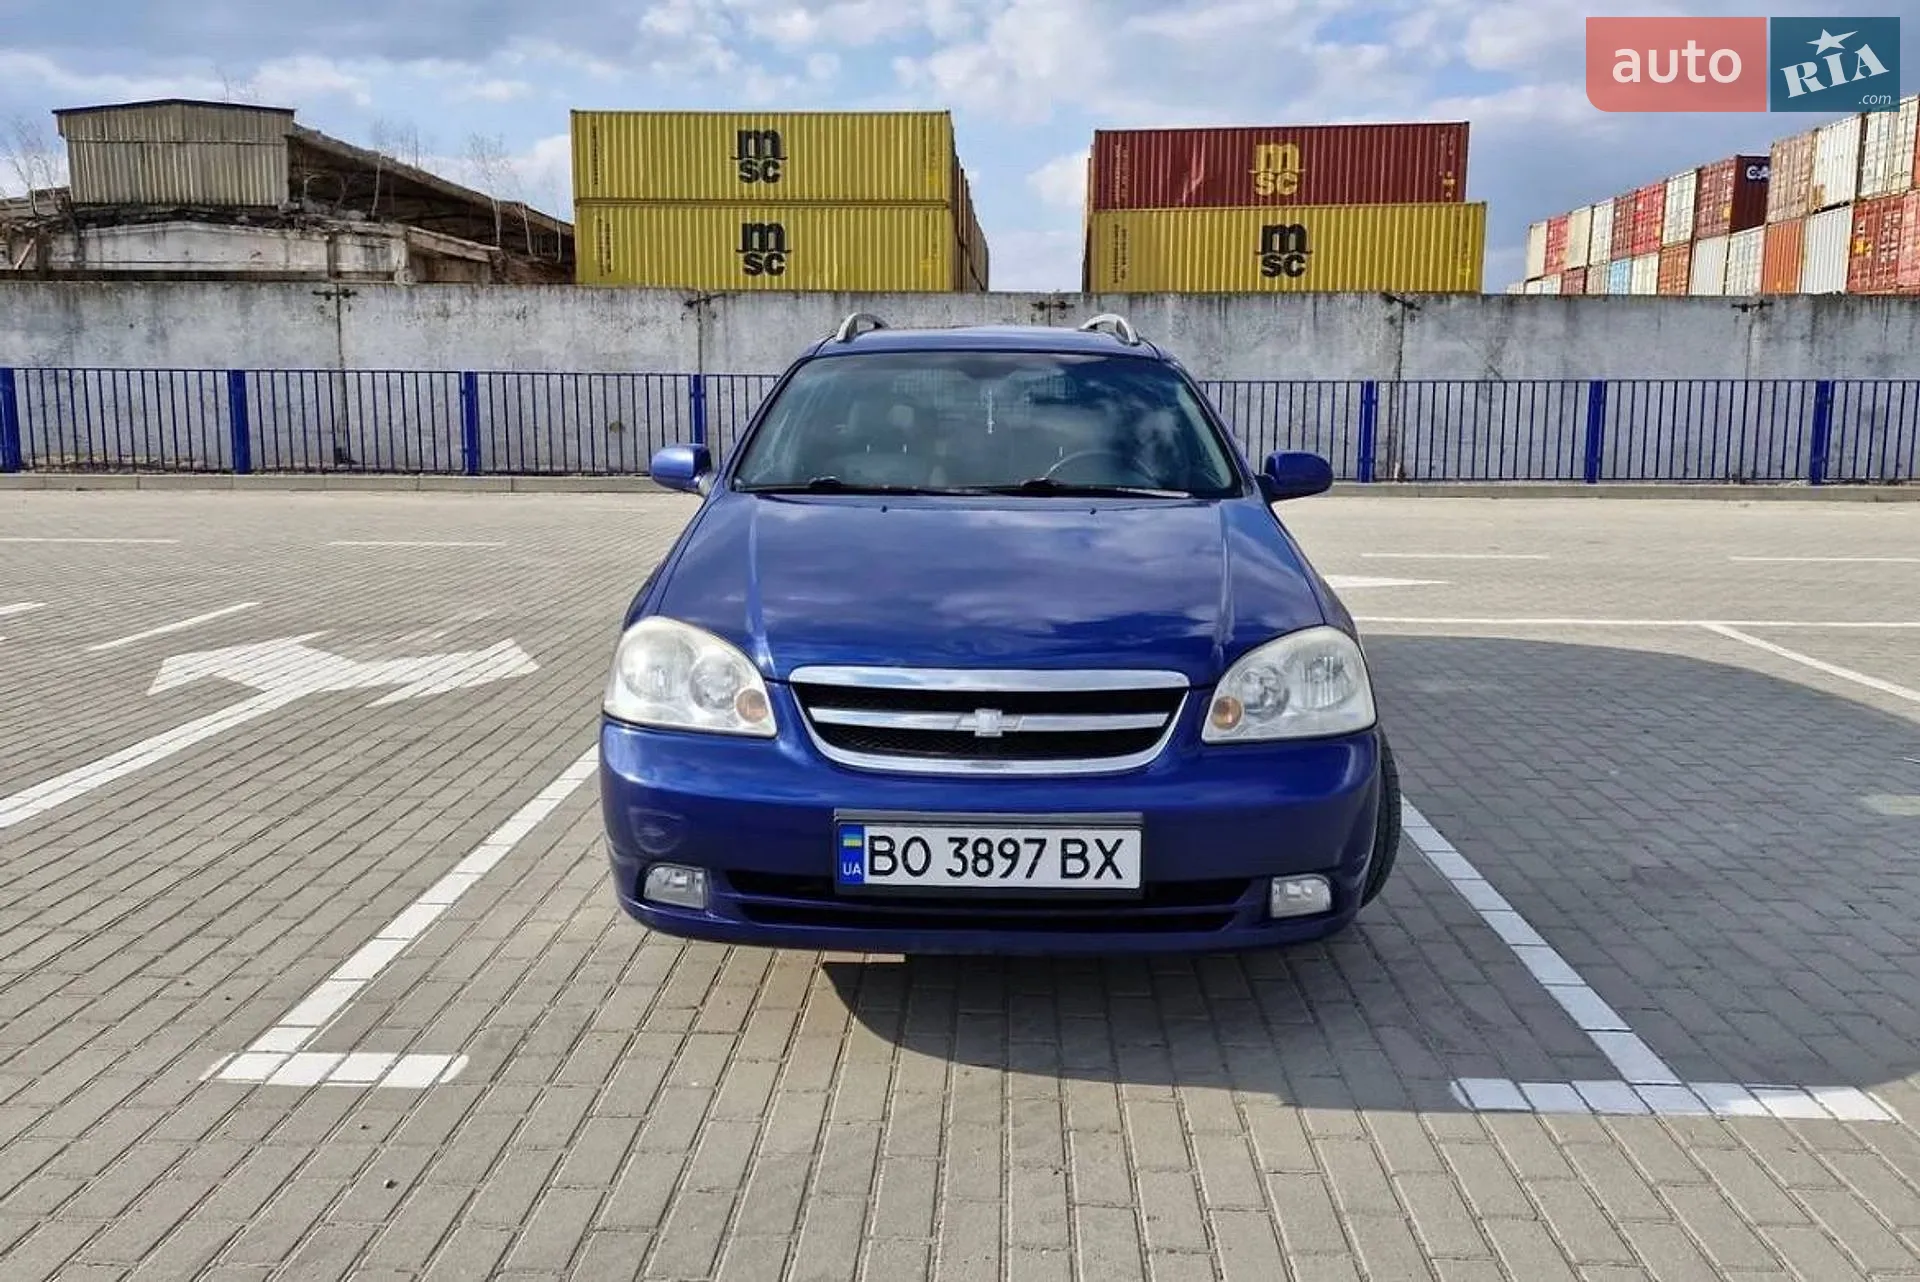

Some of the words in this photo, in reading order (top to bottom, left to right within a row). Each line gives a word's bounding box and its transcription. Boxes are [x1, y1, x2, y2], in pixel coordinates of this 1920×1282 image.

[843, 863, 862, 875] UA
[946, 837, 1047, 879] 3897
[1060, 838, 1124, 880] BX
